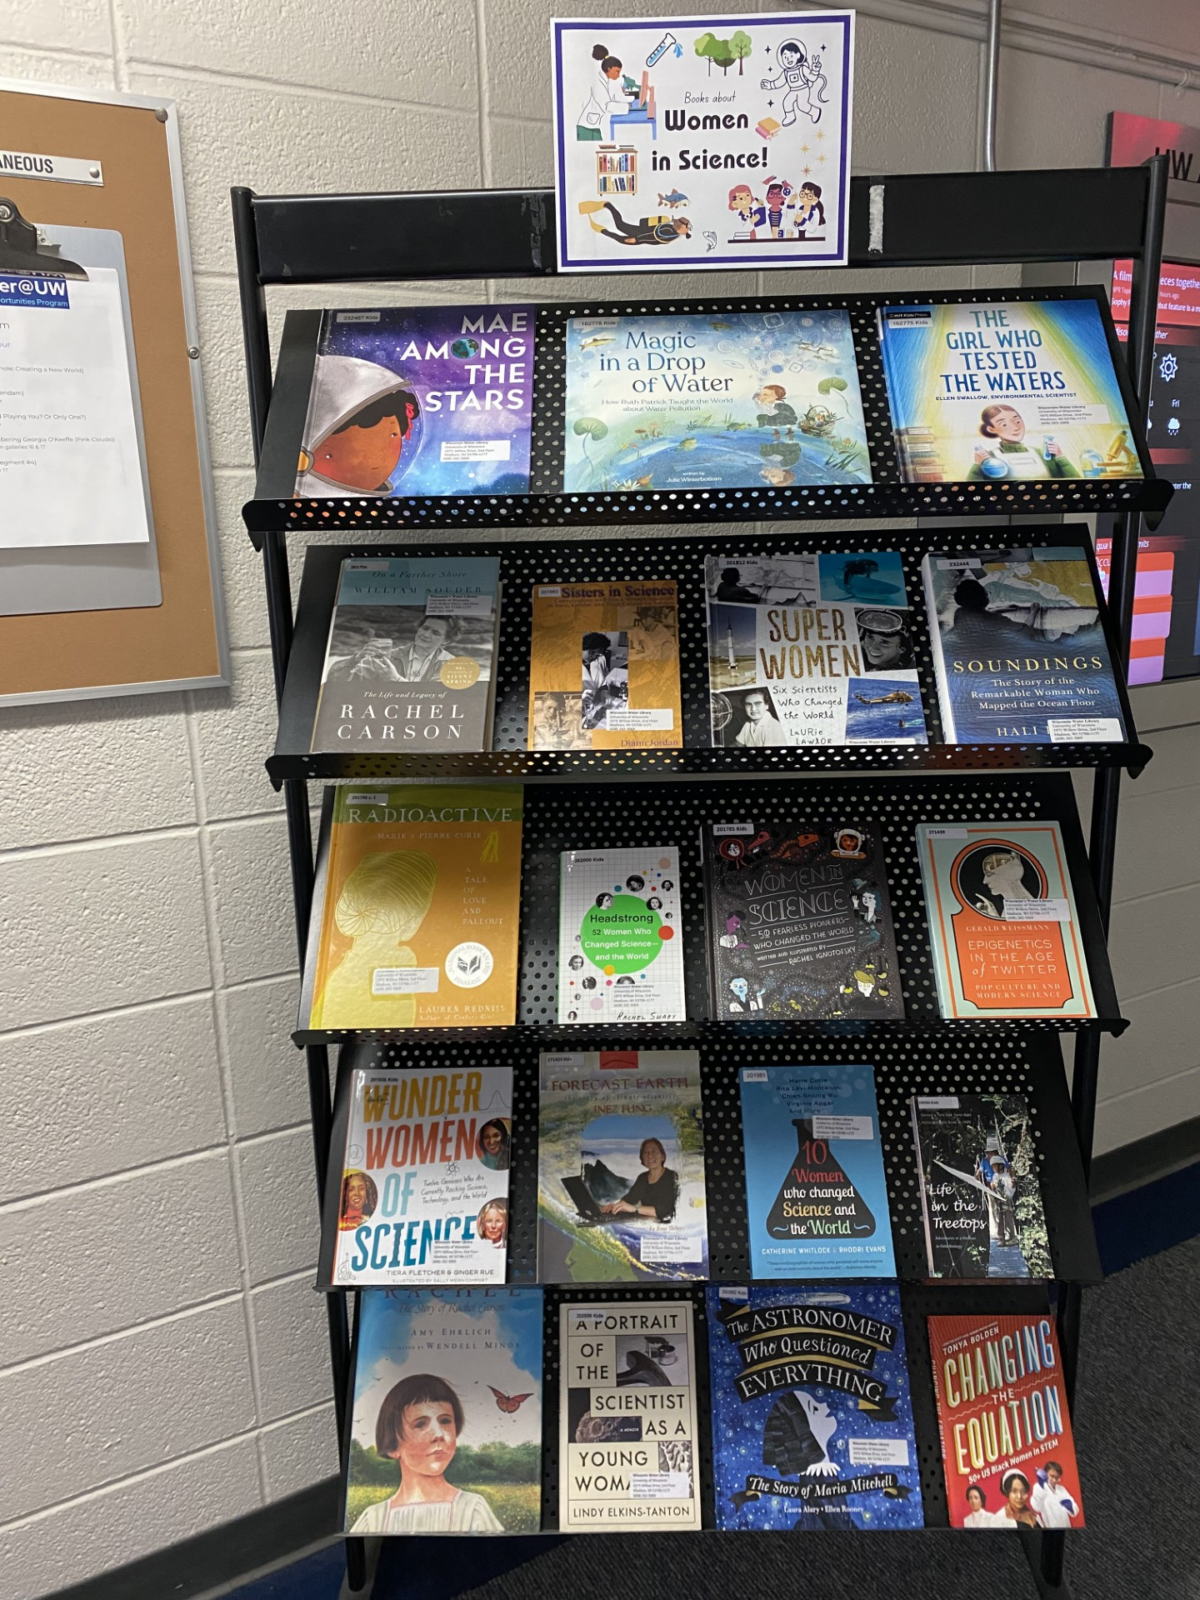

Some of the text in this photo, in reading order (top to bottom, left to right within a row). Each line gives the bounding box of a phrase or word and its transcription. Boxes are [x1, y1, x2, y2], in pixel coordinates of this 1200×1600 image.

[684, 90, 736, 104] Books about
[665, 110, 748, 131] Women
[652, 147, 768, 171] in Science!
[461, 313, 527, 334] MAE
[970, 310, 1010, 328] THE
[626, 331, 696, 352] Magic
[946, 329, 1042, 350] GIRL WHO
[600, 353, 705, 373] in a Drop
[960, 351, 1036, 370] TESTED
[465, 364, 525, 384] THE
[940, 371, 1065, 392] THE WATERS
[632, 375, 733, 393] of Water
[425, 390, 524, 412] STARS
[561, 587, 605, 598] Sisters
[609, 587, 620, 597] in
[625, 586, 674, 596] Science
[767, 609, 846, 642] SUPER
[760, 645, 861, 680] WOMEN
[954, 657, 1102, 673] SOUNDINGS
[773, 685, 837, 694] Six Scientists
[1015, 679, 1041, 687] Story
[1058, 677, 1075, 685] the
[971, 687, 1099, 698] Remarkable Woman Who
[778, 697, 842, 708] Who Changed
[979, 701, 1017, 711] Mapped
[340, 705, 464, 719] RACHEL
[784, 711, 798, 719] the
[337, 725, 462, 739] CARSON
[997, 727, 1037, 736] HALI
[349, 808, 513, 823] RADIOACTIVE
[745, 864, 844, 895] WOMEN IN
[749, 889, 848, 925] SCIENCE
[590, 914, 653, 924] Headstrong
[773, 923, 807, 936] FEARLESS
[585, 941, 619, 949] Changed
[753, 927, 854, 950] WHO CHANGED THE WORLD
[968, 939, 1052, 950] EPIGENETICS
[789, 946, 855, 965] RACHEL IGNOTOFSKY
[970, 952, 1055, 962] IN THE AGE
[972, 963, 1057, 977] of TWITTER
[419, 1005, 505, 1014] LAUREN REDNISS
[552, 1077, 688, 1092] FORECAST EARTH
[594, 1103, 652, 1114] INEZ FUNG
[366, 1118, 476, 1170] WOMEN
[802, 1140, 827, 1165] 10
[792, 1168, 844, 1183] Women
[381, 1171, 417, 1218] OF
[784, 1185, 855, 1201] who changed
[929, 1184, 955, 1197] Life
[783, 1202, 856, 1217] Science and
[931, 1200, 978, 1212] in the
[790, 1219, 852, 1235] the World
[933, 1217, 987, 1232] Treetops
[727, 1308, 892, 1345] The ASTRONOMER
[943, 1339, 968, 1355] TONYA
[971, 1326, 999, 1344] BOLDEN
[580, 1343, 604, 1357] OF
[743, 1336, 871, 1365] Who Questioned
[944, 1319, 1055, 1409] CHANGING
[576, 1366, 609, 1380] THE
[739, 1363, 883, 1401] EVERYTHING
[595, 1394, 685, 1410] SCIENTIST
[991, 1388, 1015, 1405] THE
[645, 1420, 686, 1435] AS A
[953, 1385, 1063, 1476] EQUATION
[579, 1451, 648, 1467] YOUNG
[981, 1469, 990, 1478] US
[991, 1461, 1009, 1474] Black
[1010, 1451, 1032, 1466] Women
[1033, 1447, 1039, 1456] in
[1040, 1438, 1058, 1453] STEM
[575, 1476, 631, 1491] WOM
[750, 1475, 893, 1499] The Story of Maria Mitchell
[573, 1506, 689, 1518] LINDY ELKINS-TANTON
